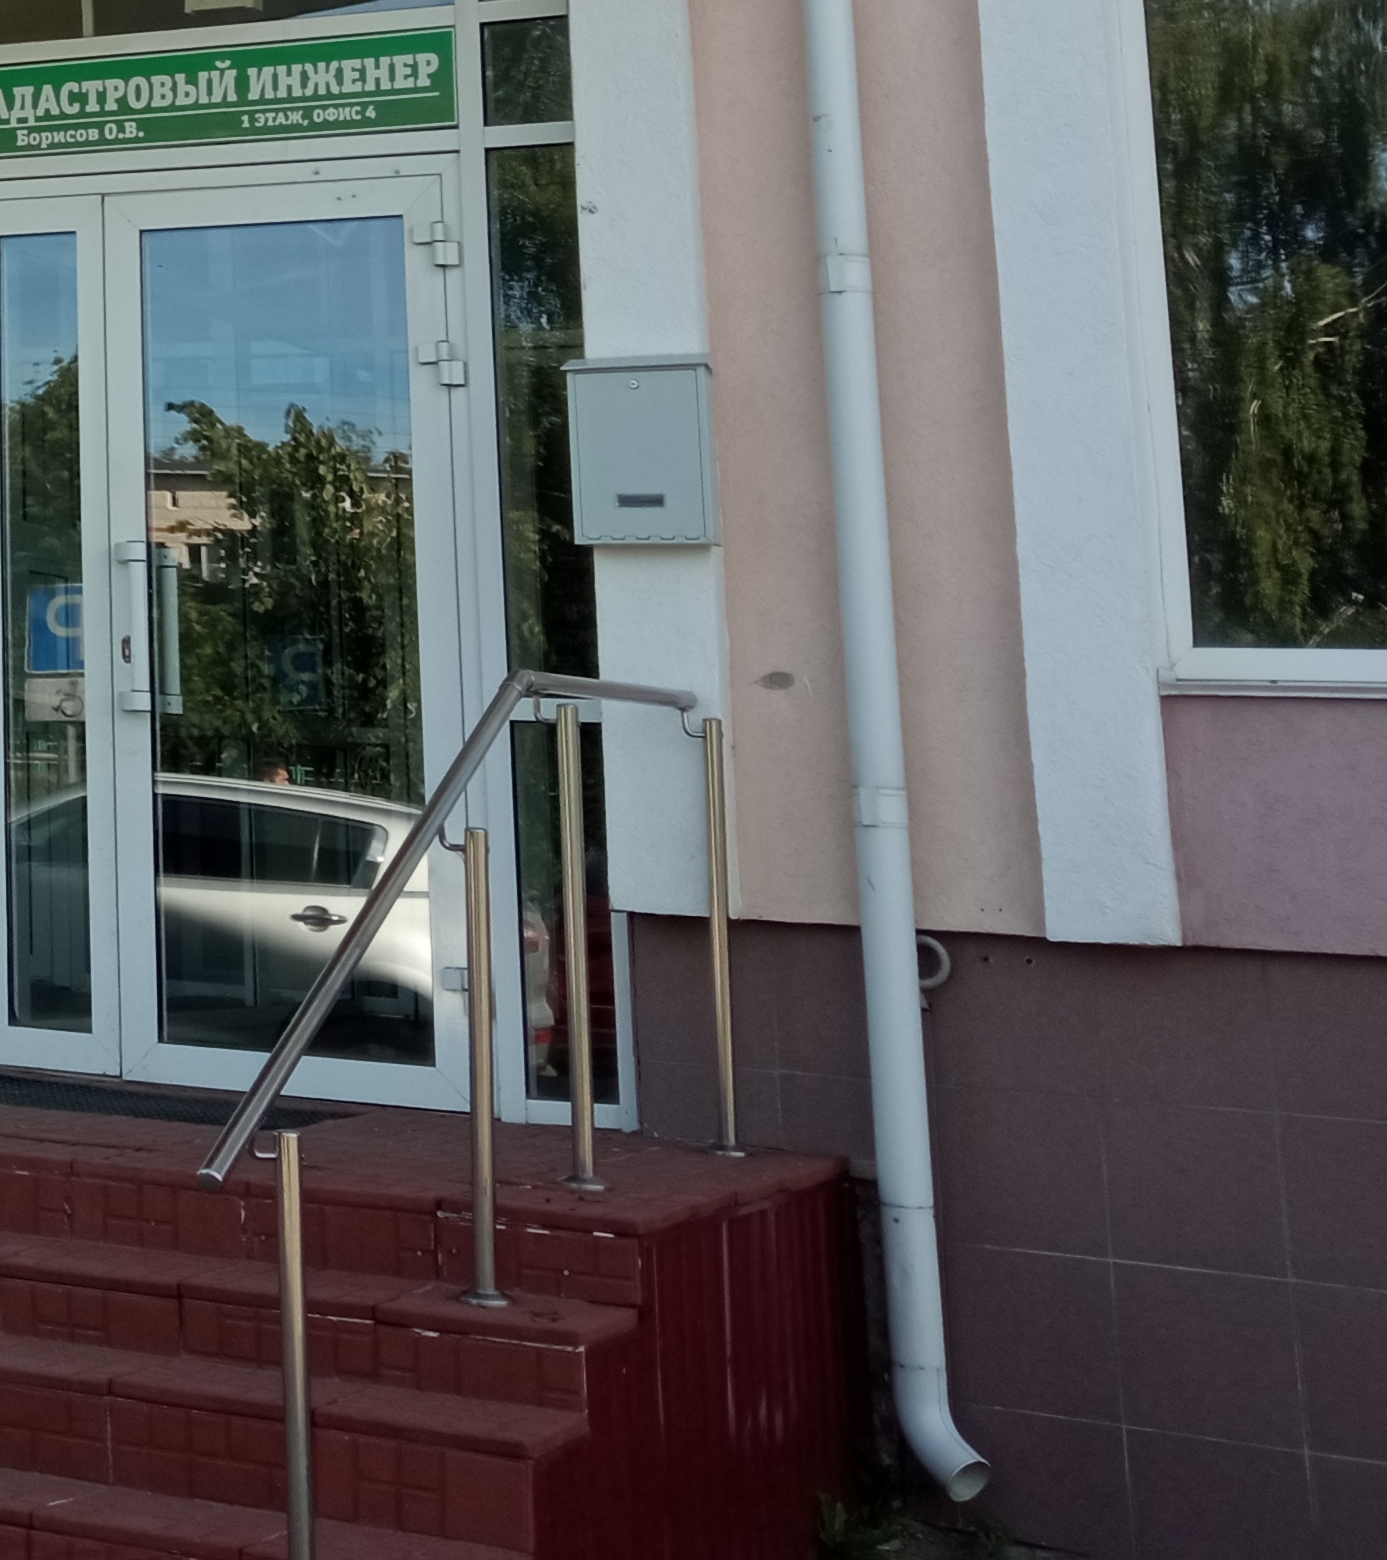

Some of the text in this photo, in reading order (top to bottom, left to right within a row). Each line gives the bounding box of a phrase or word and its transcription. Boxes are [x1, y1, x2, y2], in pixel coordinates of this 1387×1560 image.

[247, 52, 440, 101] ИНЖЕНЕР
[240, 105, 376, 128] 1 ЭТАЖ, ОФИС 4
[15, 121, 145, 149] Борисов О.В.
